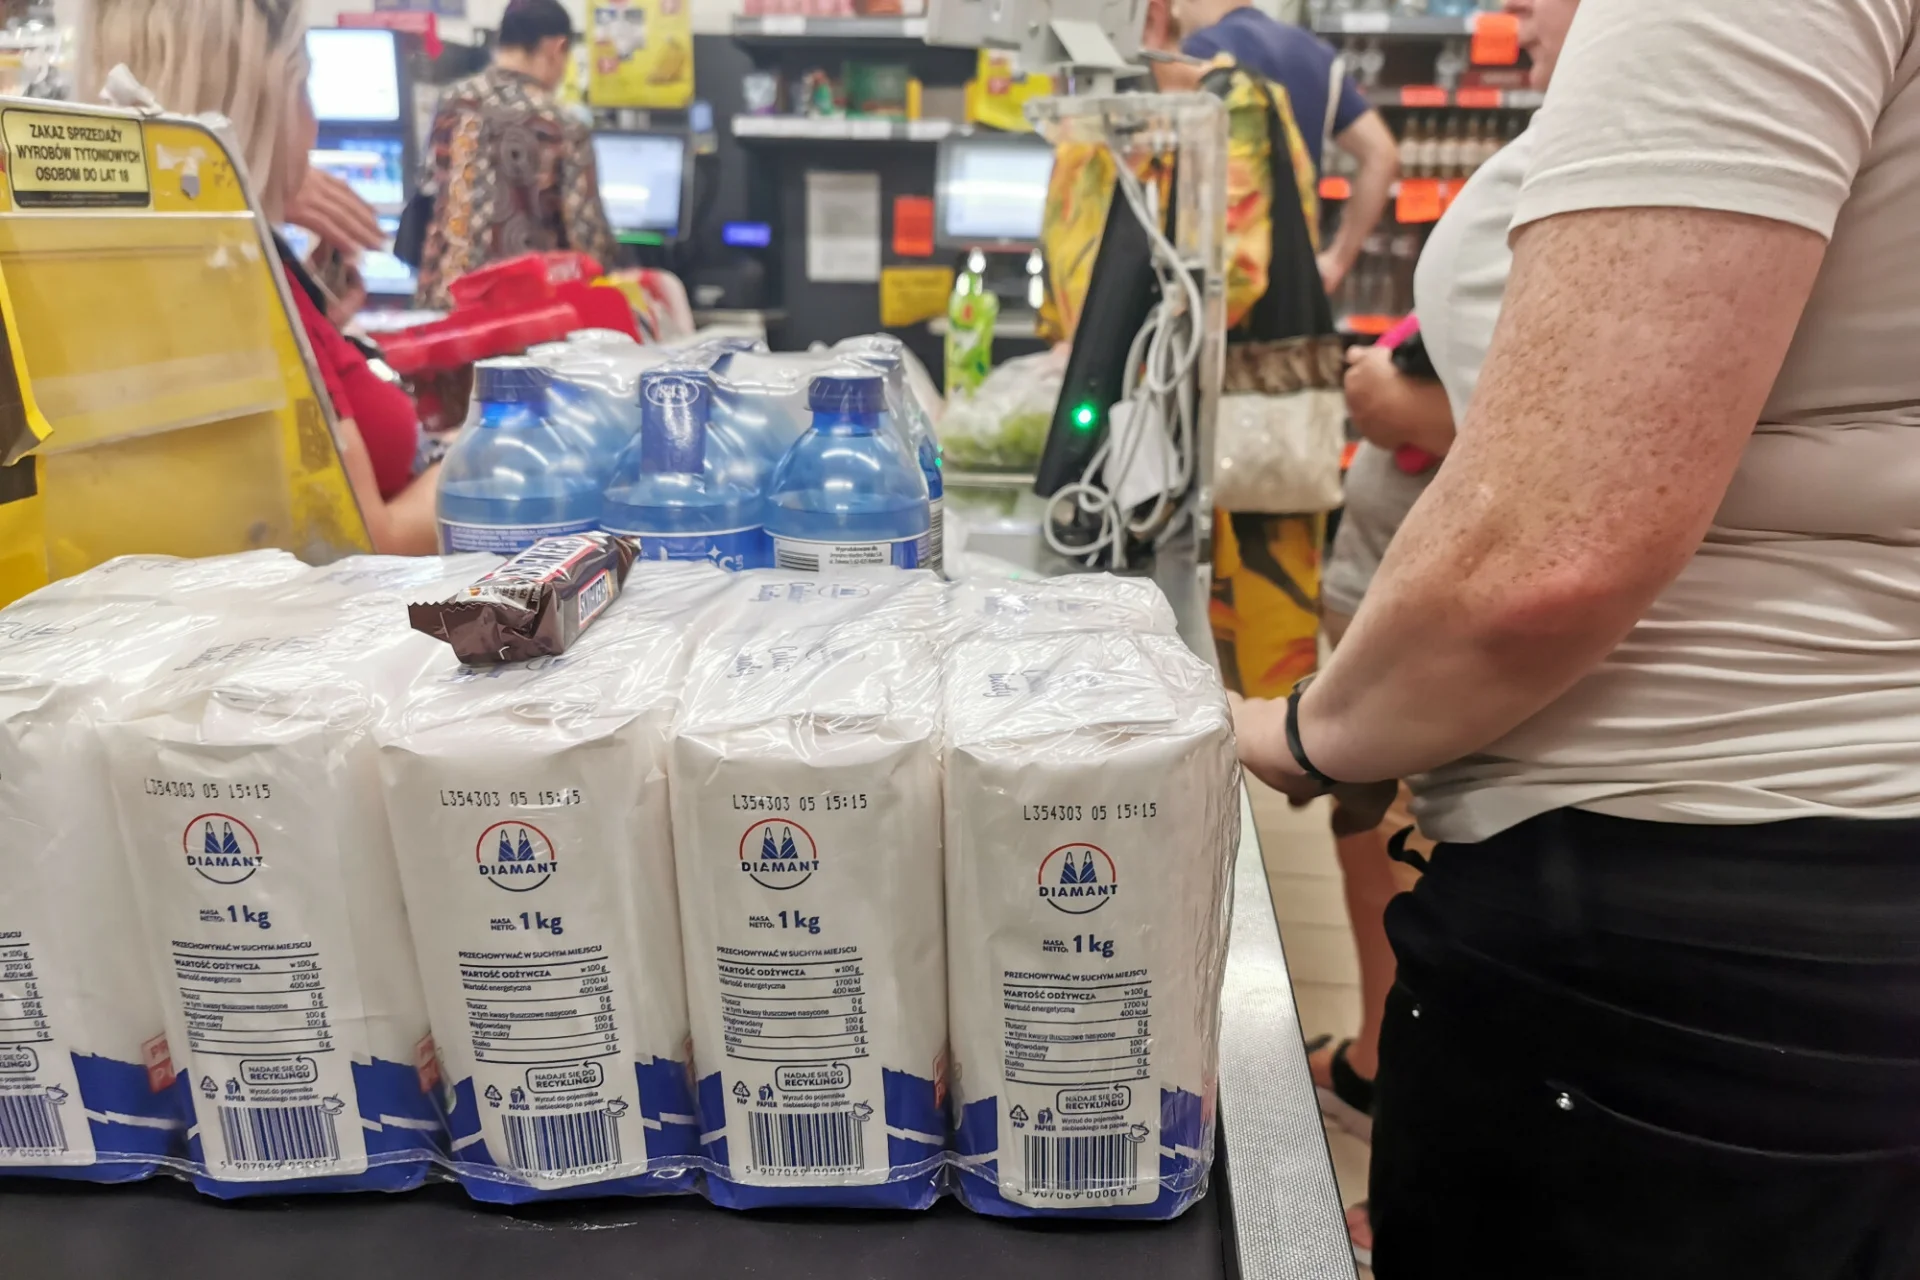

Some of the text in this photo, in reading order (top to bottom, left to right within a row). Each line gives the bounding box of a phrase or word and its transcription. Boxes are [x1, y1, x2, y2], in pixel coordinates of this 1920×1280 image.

[29, 124, 122, 142] ZAKAZ SPRZEDAŻY
[16, 143, 140, 163] WYROBÓW TYTONIOWYCH
[36, 167, 129, 182] OSOBOM DO LAT 18
[144, 778, 271, 799] L354303 05 15:15
[440, 790, 581, 807] L354303 05 15:15
[732, 794, 867, 811] L354303 05 15:15
[1024, 803, 1156, 821] L354303 05 15:15
[187, 856, 263, 867] DIAMANT
[741, 860, 820, 872] DIAMANT
[479, 862, 558, 875] DIAMANT
[1039, 884, 1118, 897] DIAMANT
[227, 905, 271, 929] 1 kg
[778, 910, 820, 934] 1 kg
[520, 912, 563, 935] 1 kg
[172, 940, 233, 951] PRZECHOWYWAĆ
[276, 941, 312, 950] MIEJSCU
[717, 946, 778, 957] PRZECHOWYWAĆ
[824, 946, 857, 955] MIEJSCU
[1073, 934, 1114, 958] 1 kg
[459, 951, 523, 960] PRZECHOWYWAĆ
[532, 950, 567, 959] SUCHYM
[568, 945, 602, 955] MIEJSCU
[174, 958, 212, 969] WARTOŚĆ
[212, 962, 261, 970] ODŻYWCZA
[312, 961, 317, 969] g
[718, 964, 756, 976] WARTOŚĆ
[757, 968, 806, 976] ODŻYWCZA
[841, 965, 854, 973] 100
[854, 966, 860, 975] g
[292, 973, 310, 981] 1700
[461, 969, 501, 978] WARTOŚĆ
[502, 970, 551, 978] ODŻYWCZA
[601, 965, 606, 973] g
[1004, 970, 1071, 981] PRZECHOWYWAĆ
[1081, 973, 1114, 981] SUCHYM
[1115, 969, 1148, 979] MIEJSCU
[290, 980, 320, 989] 400 kcal
[463, 983, 488, 991] Wartość
[489, 984, 531, 992] energetyczna
[582, 978, 600, 986] 1700
[595, 984, 609, 992] kcal
[719, 977, 742, 988] Wartość
[743, 981, 786, 990] energetyczna
[835, 979, 853, 987] 1700
[1004, 989, 1045, 999] WARTOŚĆ
[1047, 991, 1096, 1000] ODŻYWCZA
[1143, 989, 1148, 997] g
[1004, 1002, 1031, 1012] Wartość
[1032, 1005, 1075, 1014] energetyczna
[1123, 1001, 1141, 1009] 1700
[249, 1065, 281, 1073] NADAJE
[281, 1065, 294, 1073] SIĘ
[568, 1071, 581, 1079] SIĘ
[817, 1071, 829, 1079] SIĘ
[250, 1071, 310, 1080] RECYKLINGU
[536, 1075, 597, 1088] RECYKLINGU
[785, 1077, 844, 1086] RECYKLINGU
[782, 1094, 803, 1102] Wyrzuć
[814, 1092, 845, 1101] pojemnika
[1066, 1094, 1098, 1102] NADAJE
[1099, 1093, 1110, 1102] SIĘ
[783, 1100, 820, 1108] niebieskiego
[1066, 1099, 1124, 1110] RECYKLINGU
[1062, 1117, 1083, 1125] Wyrzuć
[1093, 1114, 1123, 1125] pojemnika
[746, 1165, 751, 1173] 5
[1087, 1188, 1132, 1199] 000017
